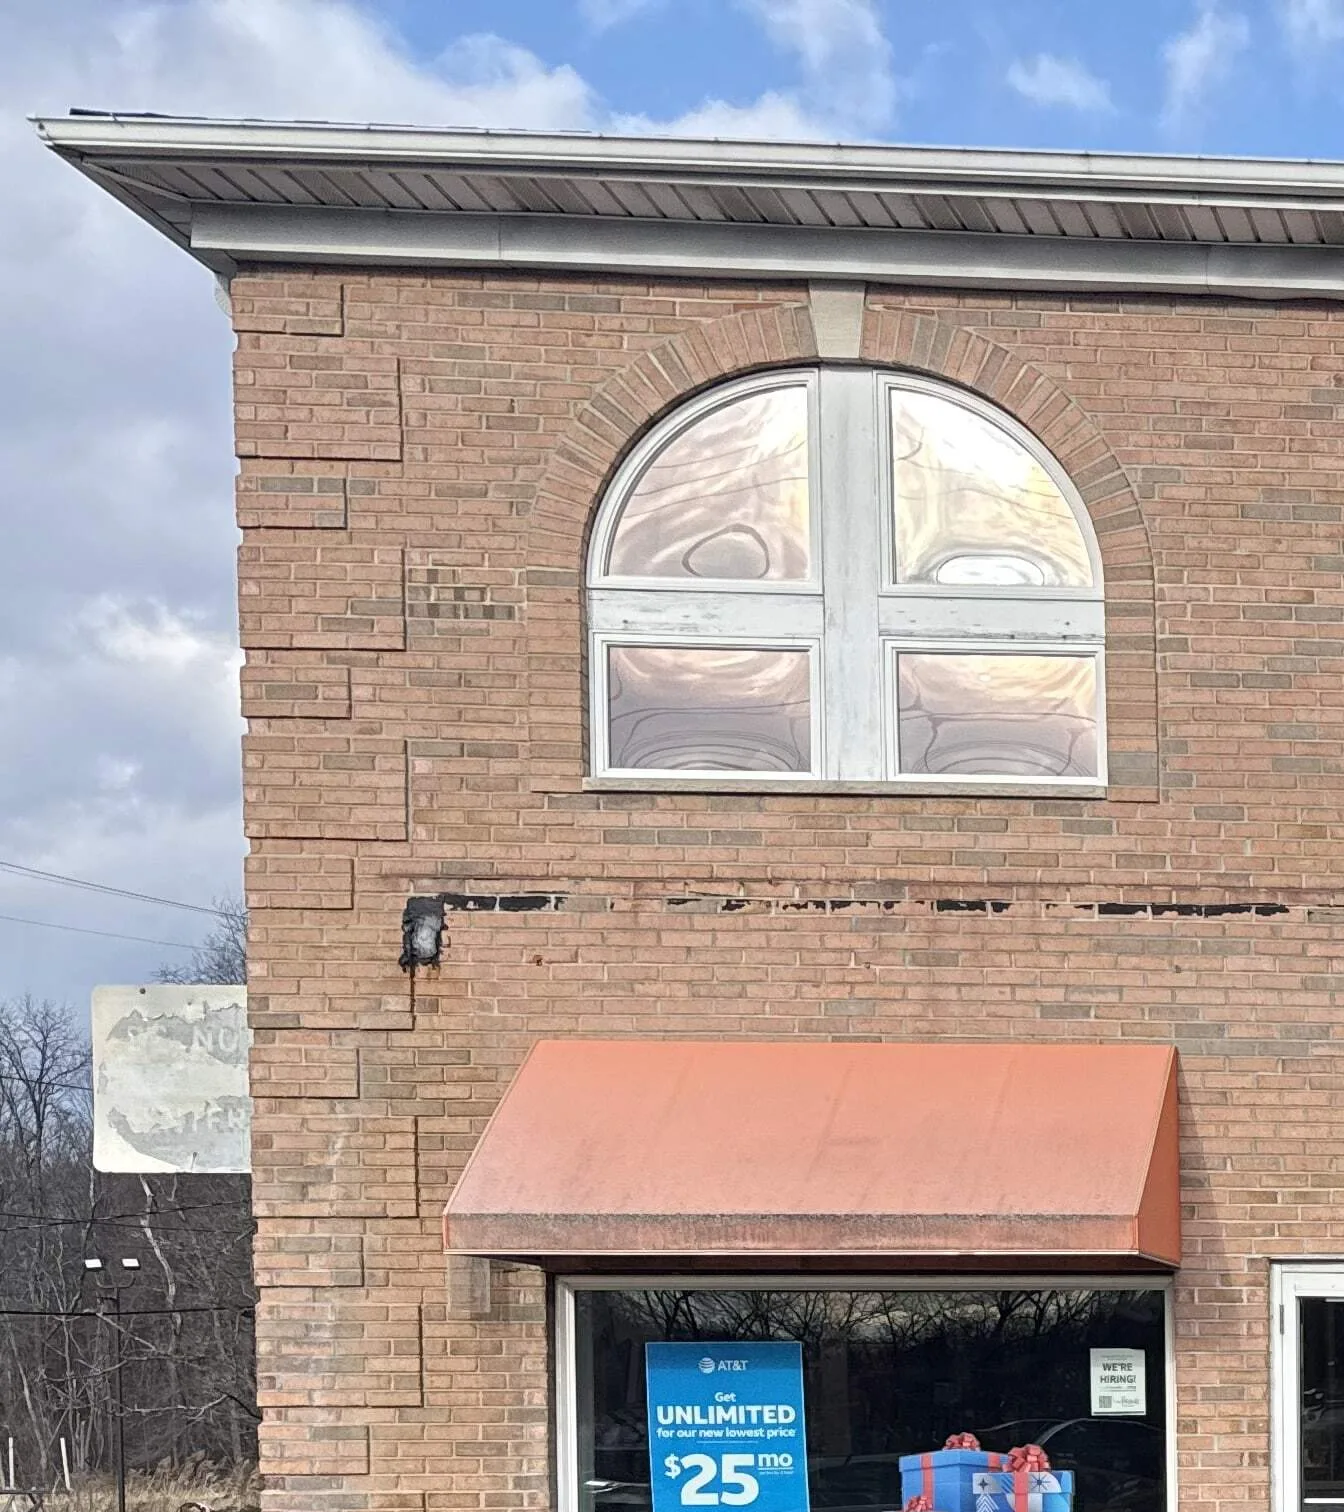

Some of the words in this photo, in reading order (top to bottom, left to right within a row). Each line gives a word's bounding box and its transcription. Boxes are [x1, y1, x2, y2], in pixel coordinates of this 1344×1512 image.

[717, 1359, 748, 1371] AT&T
[1102, 1362, 1133, 1372] WE'RE
[714, 1391, 737, 1403] Get
[656, 1405, 796, 1425] UNLIMITED
[656, 1427, 675, 1438] for
[676, 1428, 697, 1438] our
[699, 1428, 724, 1438] new
[725, 1427, 765, 1438] lowest
[766, 1427, 797, 1440] price
